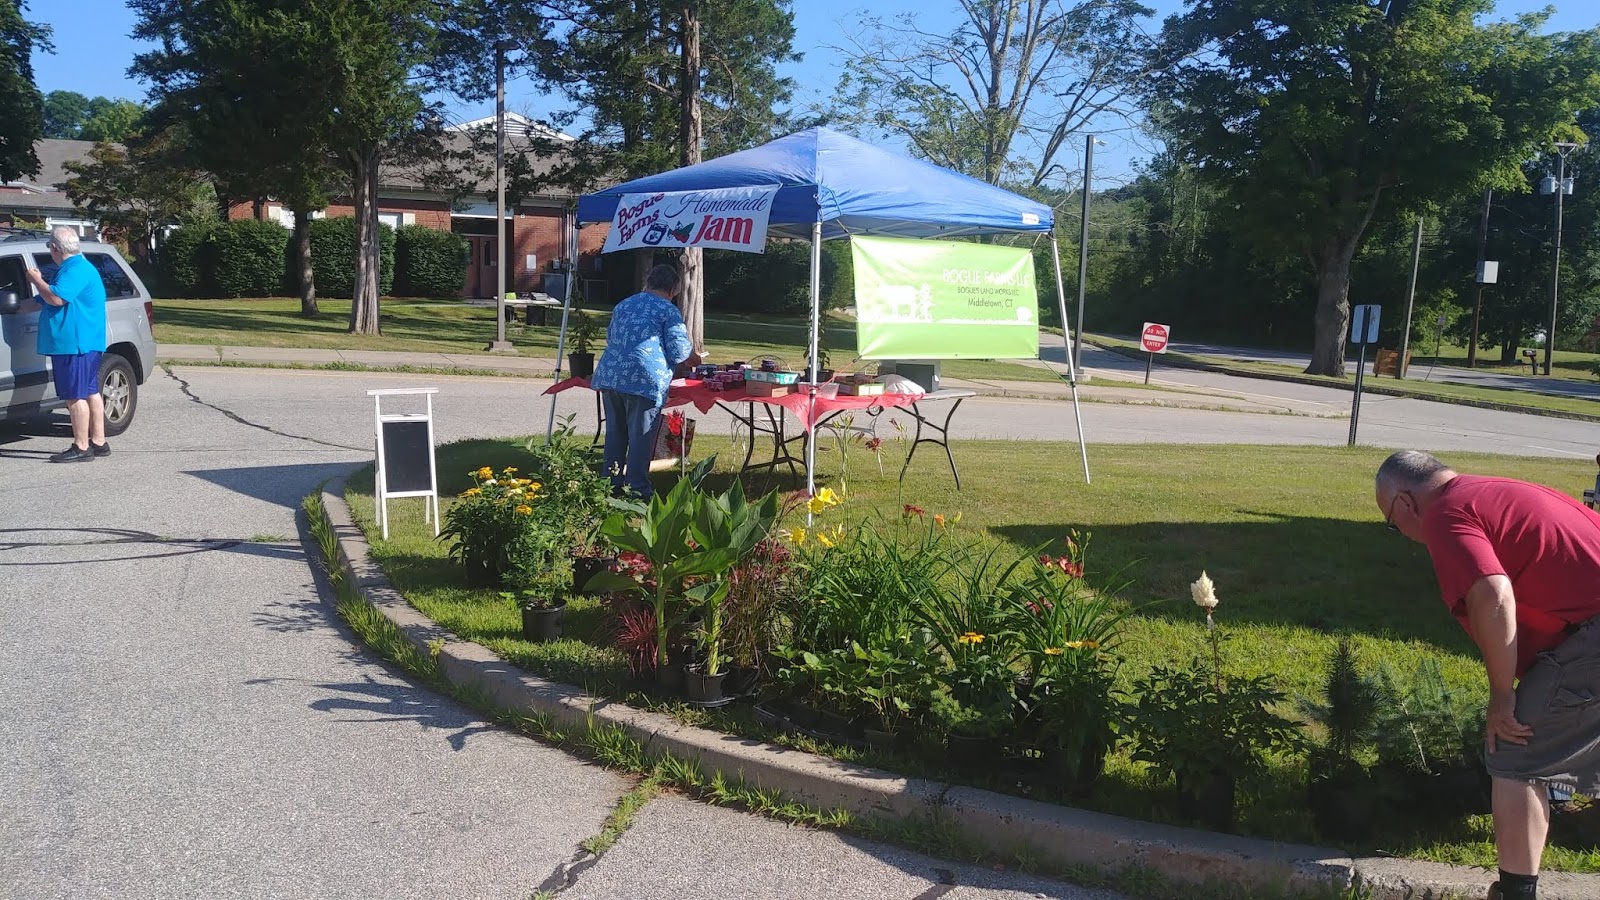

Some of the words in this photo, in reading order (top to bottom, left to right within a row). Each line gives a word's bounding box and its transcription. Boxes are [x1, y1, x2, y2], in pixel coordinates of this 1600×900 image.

[617, 192, 665, 228] Bogue
[664, 191, 769, 218] Homemade
[617, 208, 660, 247] Farms
[690, 214, 754, 245] Jam
[943, 268, 980, 284] BOGUE
[968, 297, 1004, 308] Middletown,
[1004, 299, 1013, 308] CT
